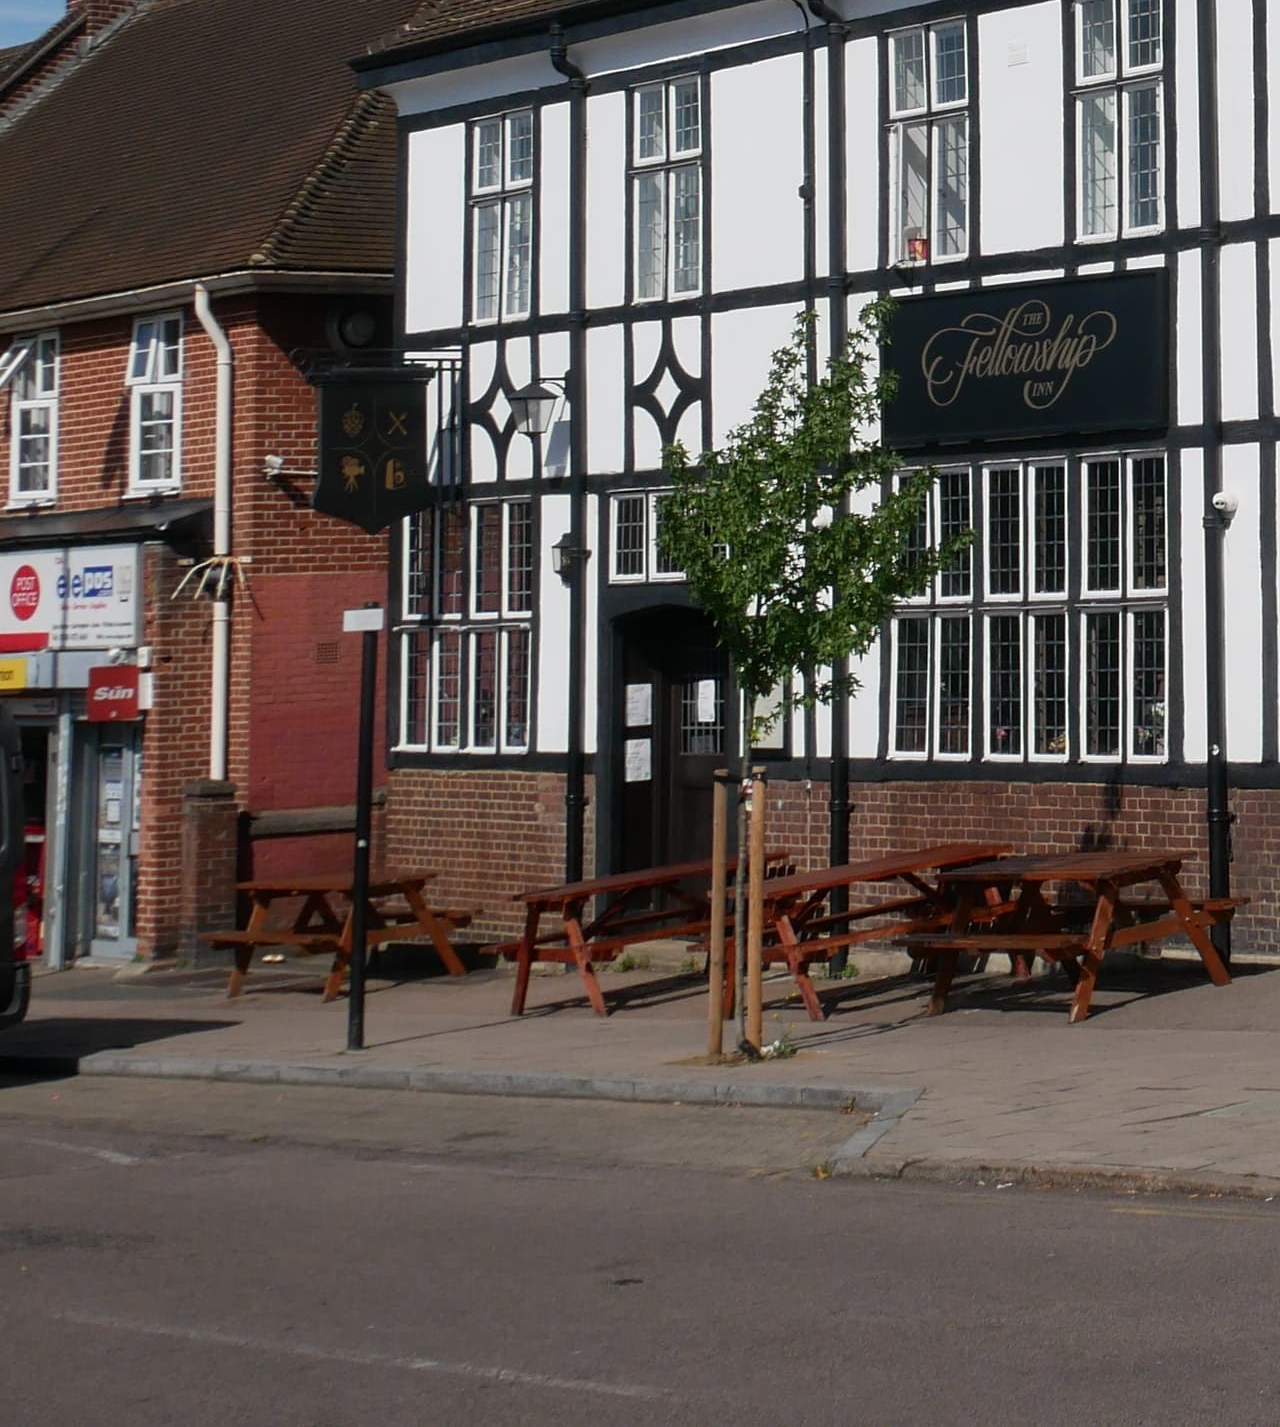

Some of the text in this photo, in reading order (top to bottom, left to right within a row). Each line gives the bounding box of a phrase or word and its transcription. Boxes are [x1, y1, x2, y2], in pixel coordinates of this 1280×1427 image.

[1022, 312, 1044, 326] THE
[922, 299, 1117, 409] Fellowship
[1031, 381, 1054, 397] INN
[16, 576, 36, 590] POST
[12, 592, 38, 606] OFFICE
